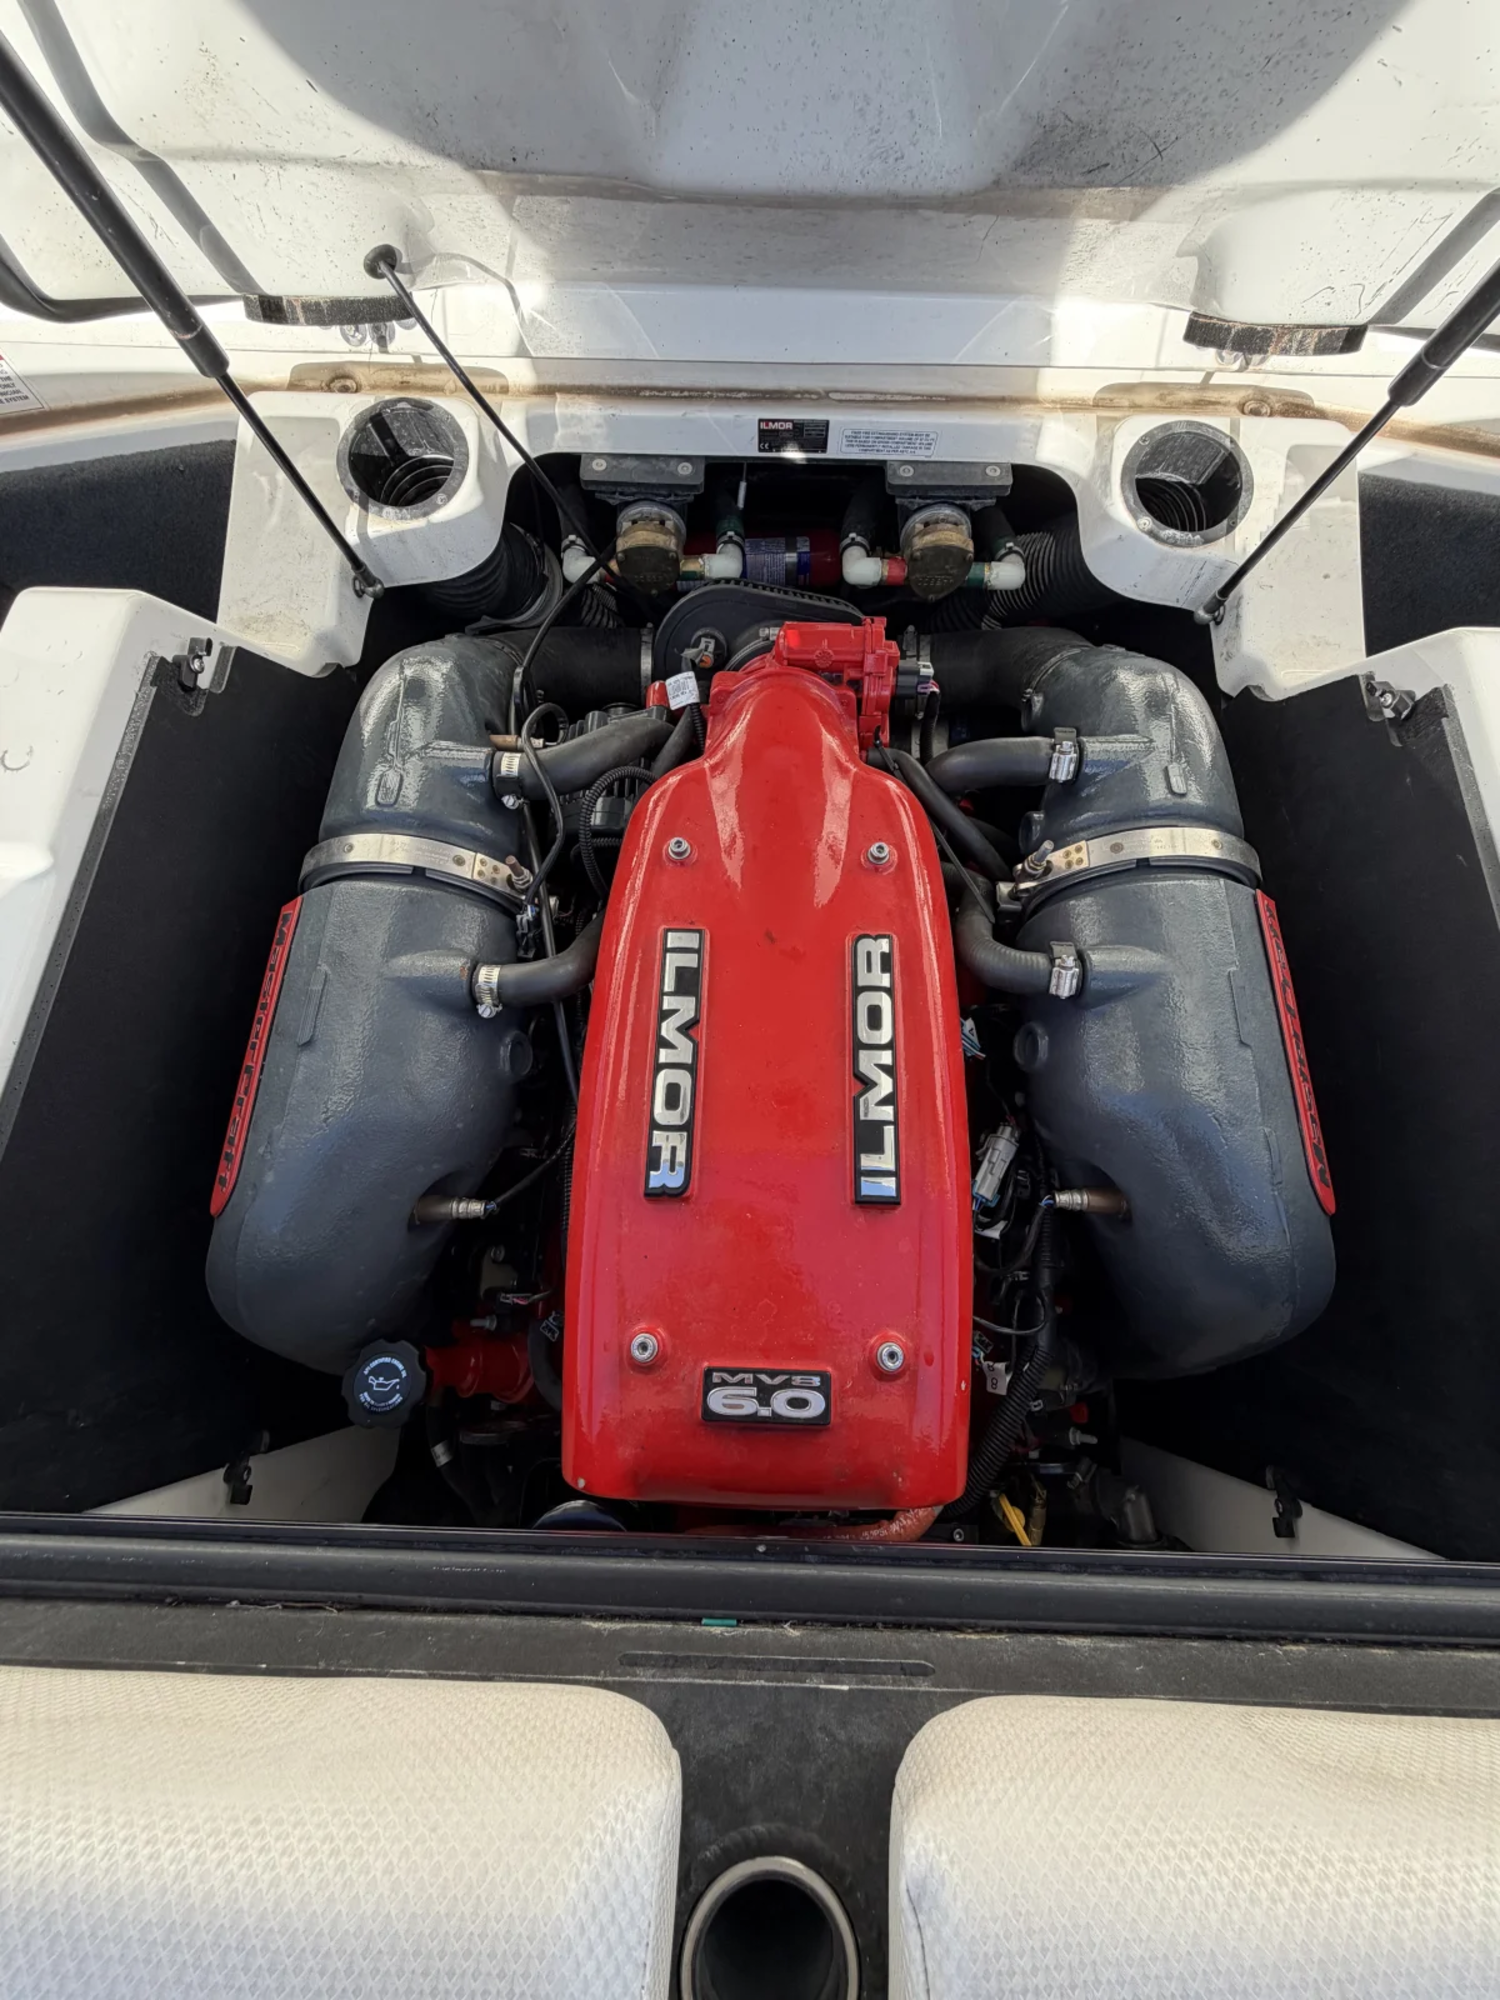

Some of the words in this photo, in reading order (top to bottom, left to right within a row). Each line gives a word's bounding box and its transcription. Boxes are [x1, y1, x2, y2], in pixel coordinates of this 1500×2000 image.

[760, 421, 793, 430] ILMOR
[648, 931, 700, 1189] ILMOR
[856, 937, 897, 1197] ILMOR
[712, 1372, 821, 1387] MV8
[706, 1386, 826, 1419] 6.0
